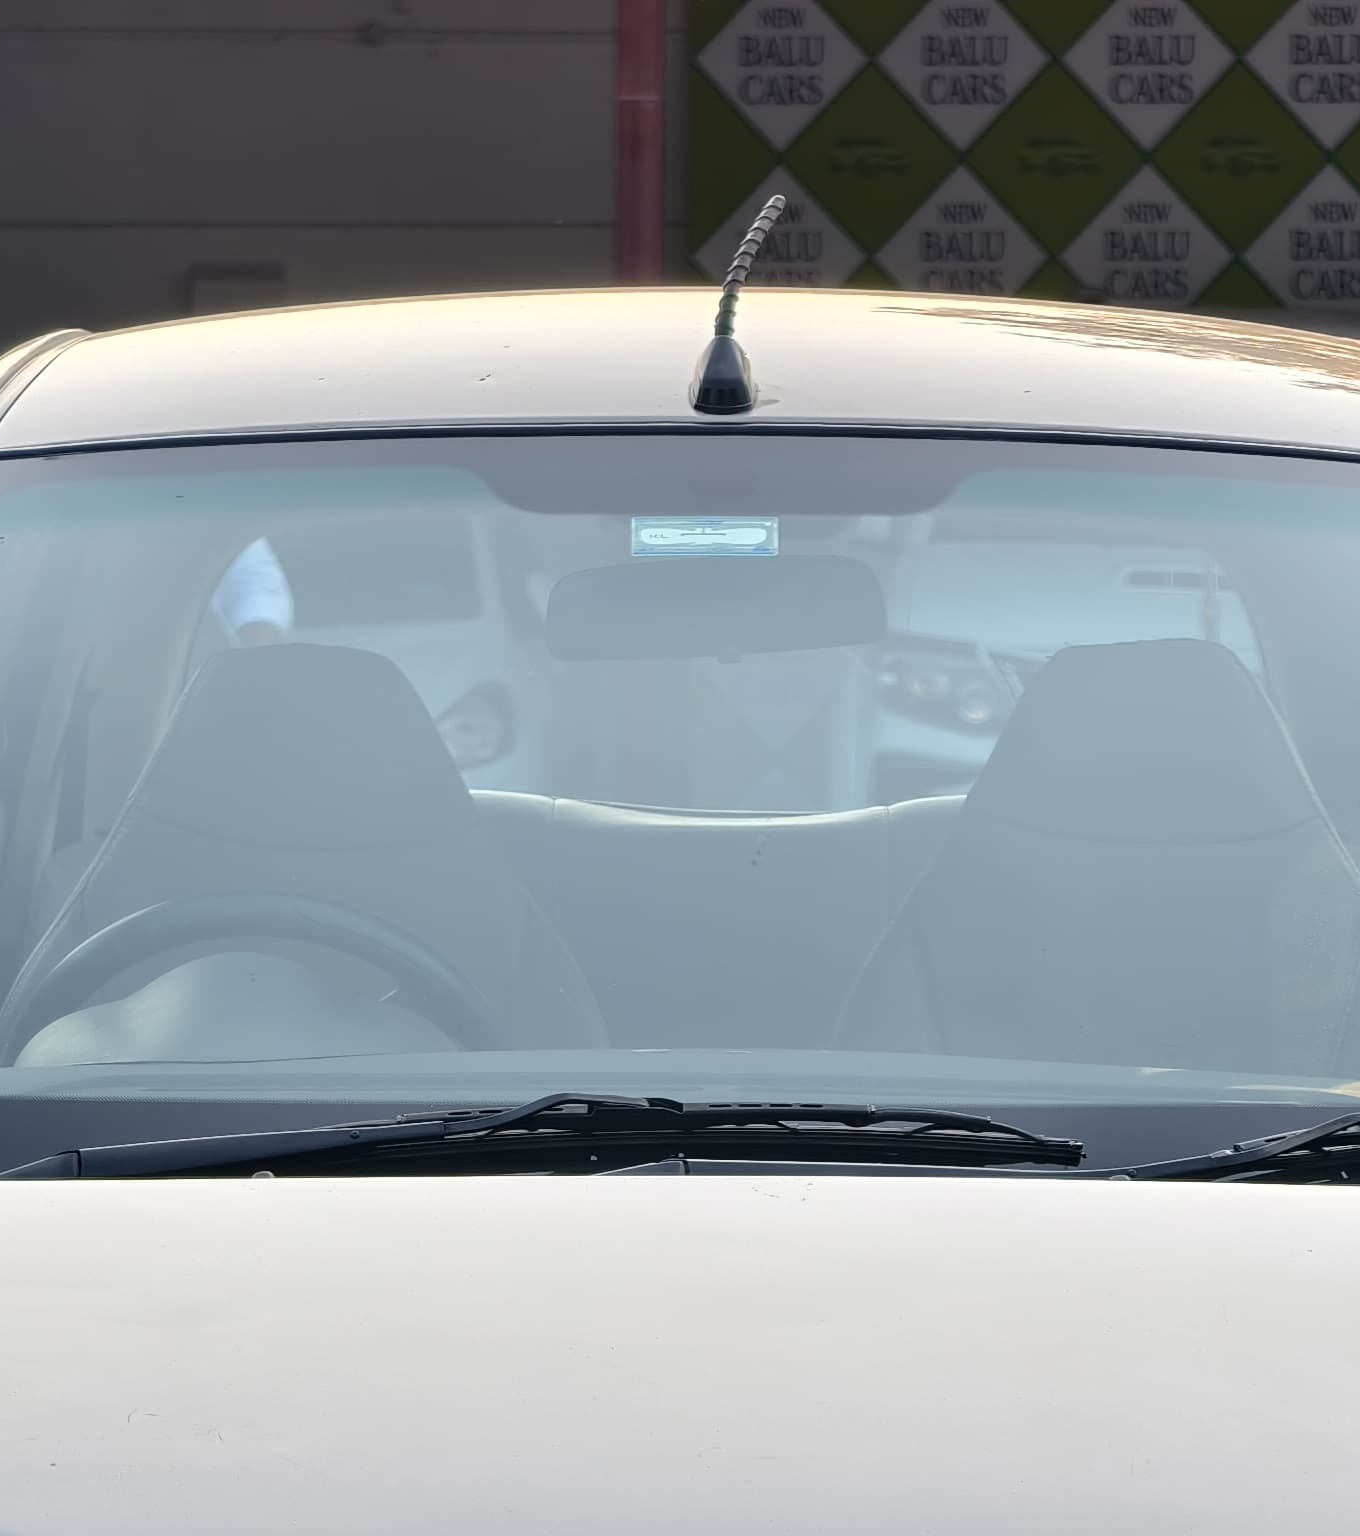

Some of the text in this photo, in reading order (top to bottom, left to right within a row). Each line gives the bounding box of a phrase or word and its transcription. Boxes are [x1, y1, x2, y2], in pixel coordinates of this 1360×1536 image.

[757, 8, 803, 27] NEW
[943, 8, 990, 27] NEW
[1129, 8, 1177, 27] NEW
[1308, 6, 1357, 26] NEW
[738, 36, 824, 66] BALU
[921, 36, 1008, 66] BALU
[1107, 35, 1195, 66] BALU
[740, 75, 823, 104] CARS
[922, 75, 1007, 104] CARS
[1108, 74, 1194, 104] CARS
[942, 204, 987, 223] NEW
[1123, 204, 1171, 223] NEW
[1309, 202, 1358, 222] NEW
[920, 232, 1006, 262] BALU
[1105, 231, 1190, 262] BALU
[1106, 270, 1190, 299] CARS
